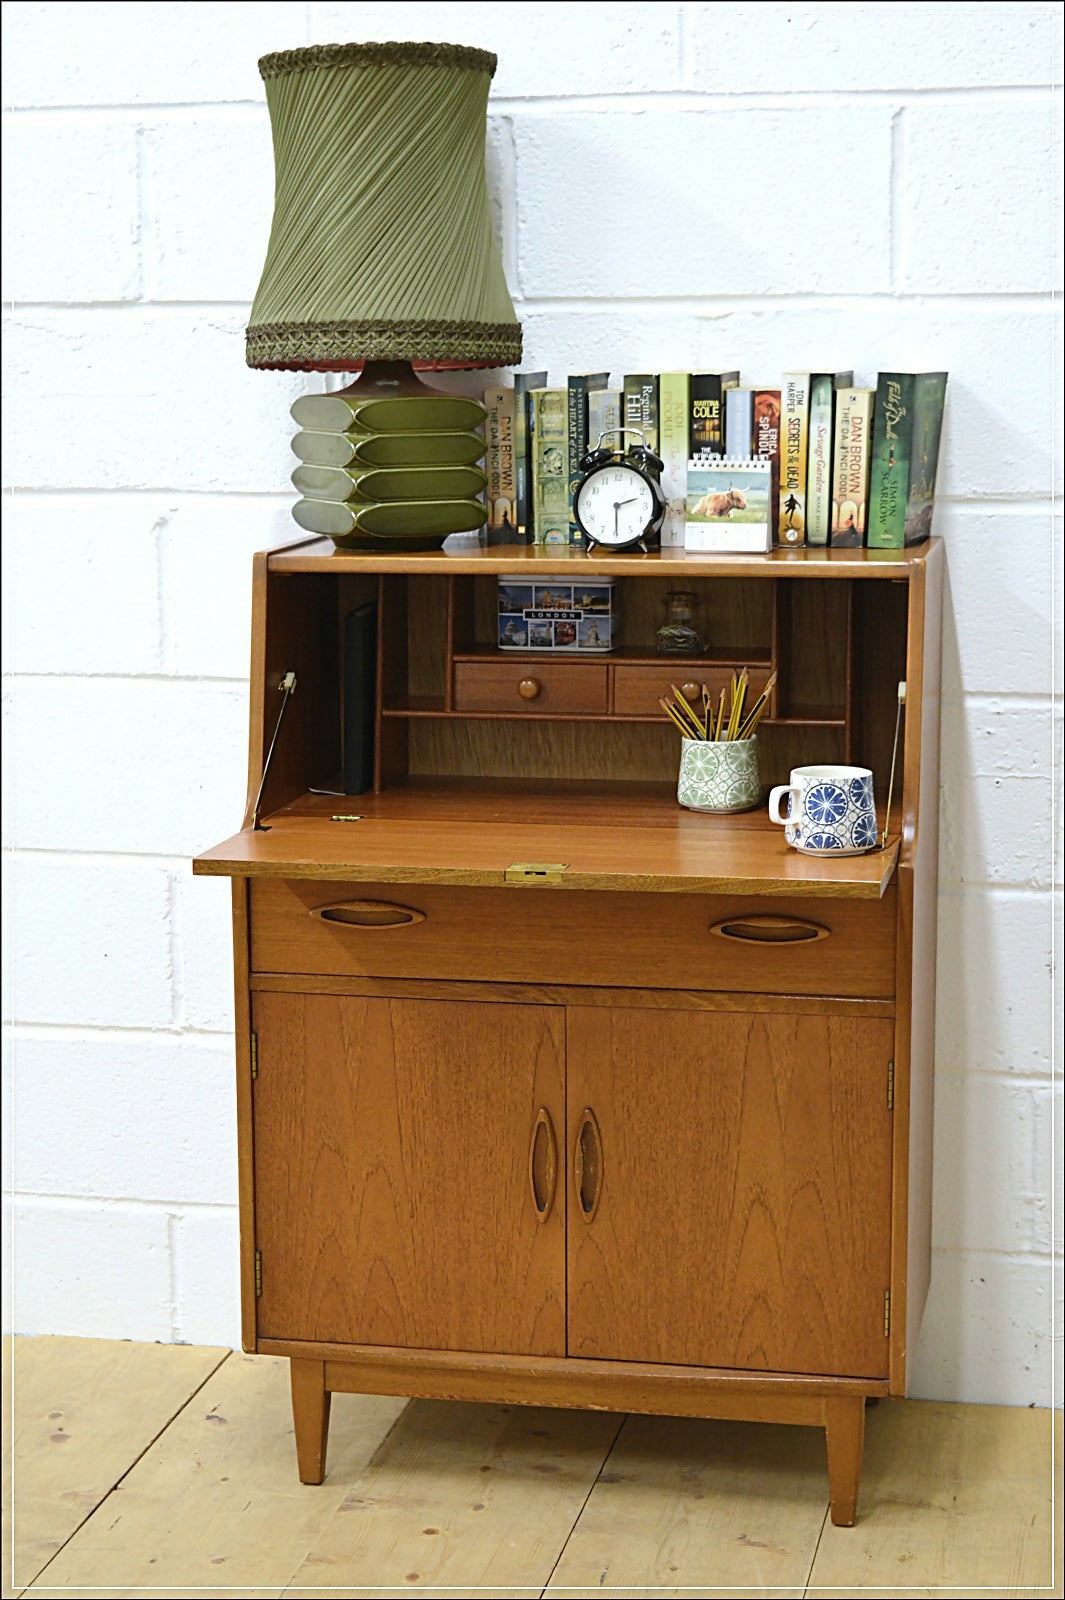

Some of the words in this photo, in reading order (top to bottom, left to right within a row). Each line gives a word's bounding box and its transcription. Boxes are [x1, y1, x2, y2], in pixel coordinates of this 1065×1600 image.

[627, 394, 641, 422] Hill
[640, 385, 654, 431] Reginald
[786, 382, 796, 413] HARPER
[796, 390, 804, 406] TOM
[490, 406, 499, 425] THE
[569, 408, 577, 439] HEART
[693, 406, 719, 418] COLE
[842, 407, 850, 425] THE
[491, 428, 499, 441] DA
[500, 416, 511, 442] DAN
[758, 416, 770, 460] SPINDLE
[767, 428, 778, 456] ERICA
[787, 418, 801, 454] SECRETS
[814, 425, 827, 459] Savage
[841, 428, 849, 441] DA
[850, 416, 863, 444] DAN
[500, 444, 513, 491] BROWN
[614, 473, 623, 482] 12
[787, 466, 799, 489] DEAD
[815, 459, 826, 493] Garden
[849, 446, 862, 494] BROWN
[491, 472, 500, 498] CODE
[592, 486, 600, 495] 10
[601, 477, 609, 486] 11
[838, 473, 848, 500] CODE
[585, 501, 592, 509] 9
[879, 471, 891, 526] SCARROW
[888, 480, 898, 518] SIMON
